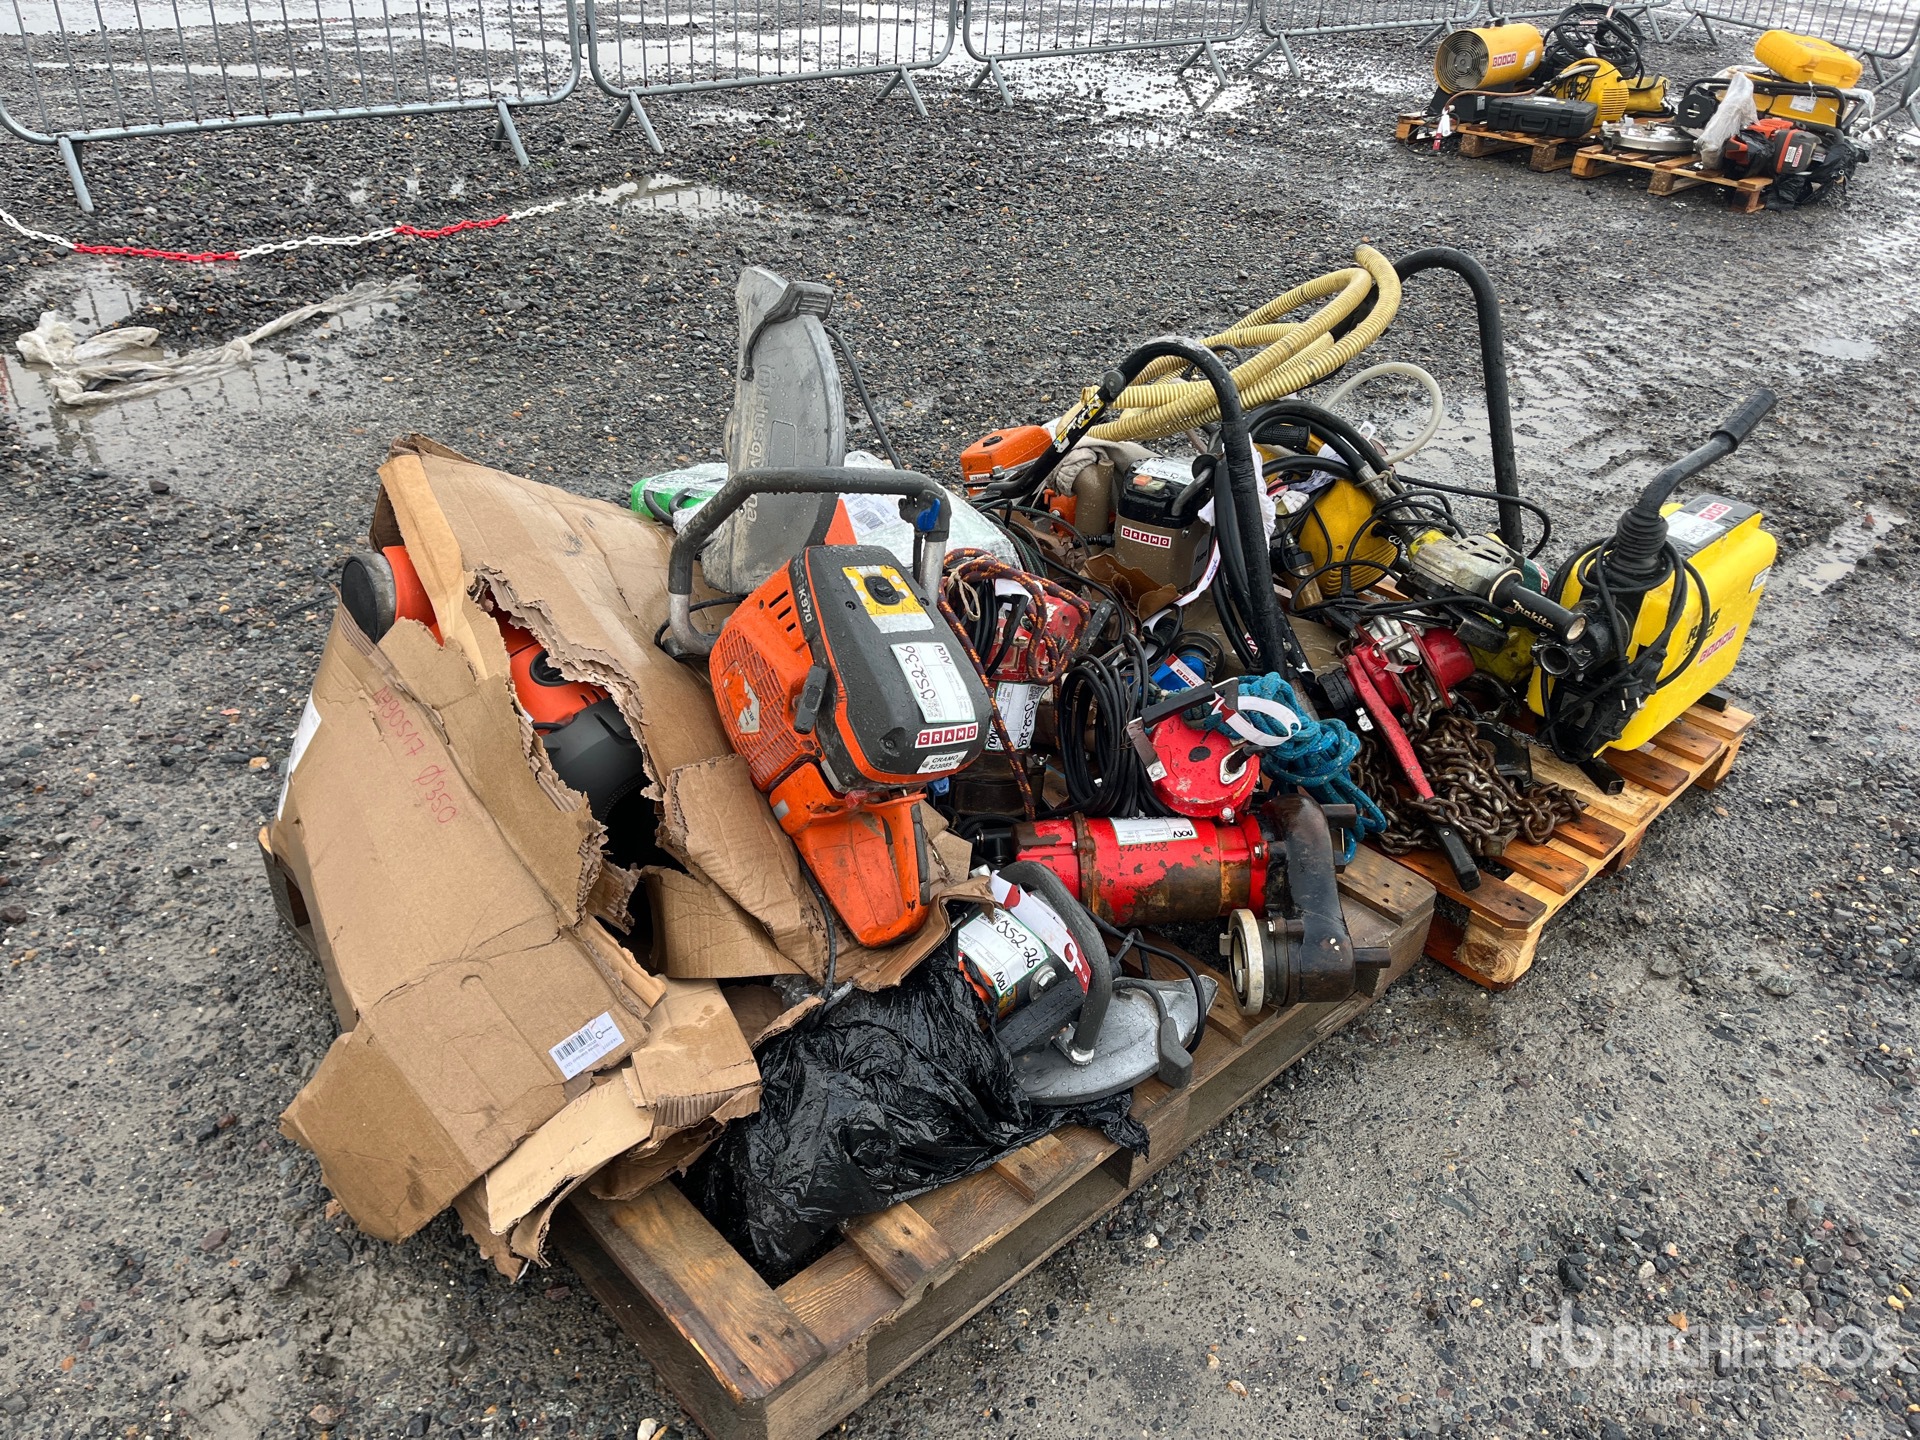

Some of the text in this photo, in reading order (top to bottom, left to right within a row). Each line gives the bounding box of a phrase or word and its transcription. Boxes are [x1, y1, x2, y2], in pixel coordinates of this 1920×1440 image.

[747, 388, 771, 523] Husqvna
[1122, 527, 1170, 547] CRAMO
[798, 588, 814, 623] K970
[918, 725, 978, 747] CRAMO
[931, 754, 959, 765] CRAMO
